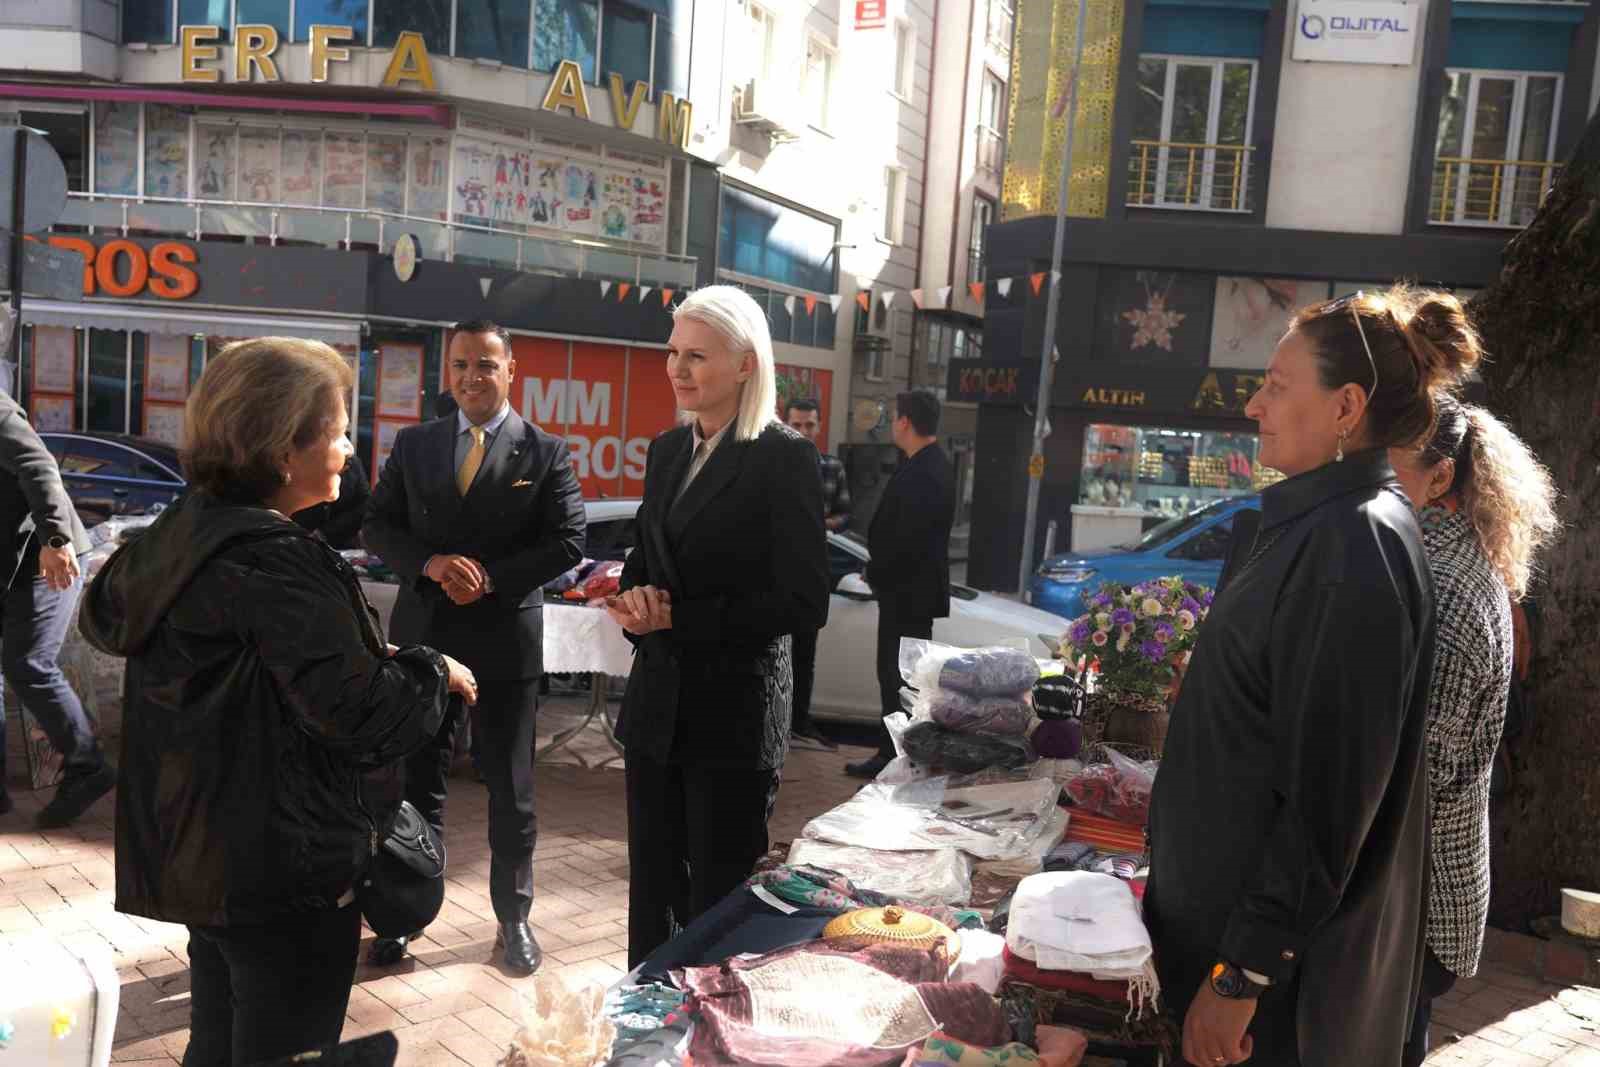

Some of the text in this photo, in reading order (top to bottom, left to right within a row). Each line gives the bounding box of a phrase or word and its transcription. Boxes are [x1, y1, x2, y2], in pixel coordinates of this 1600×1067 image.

[180, 24, 693, 152] ERFA AVM
[522, 376, 611, 426] MM
